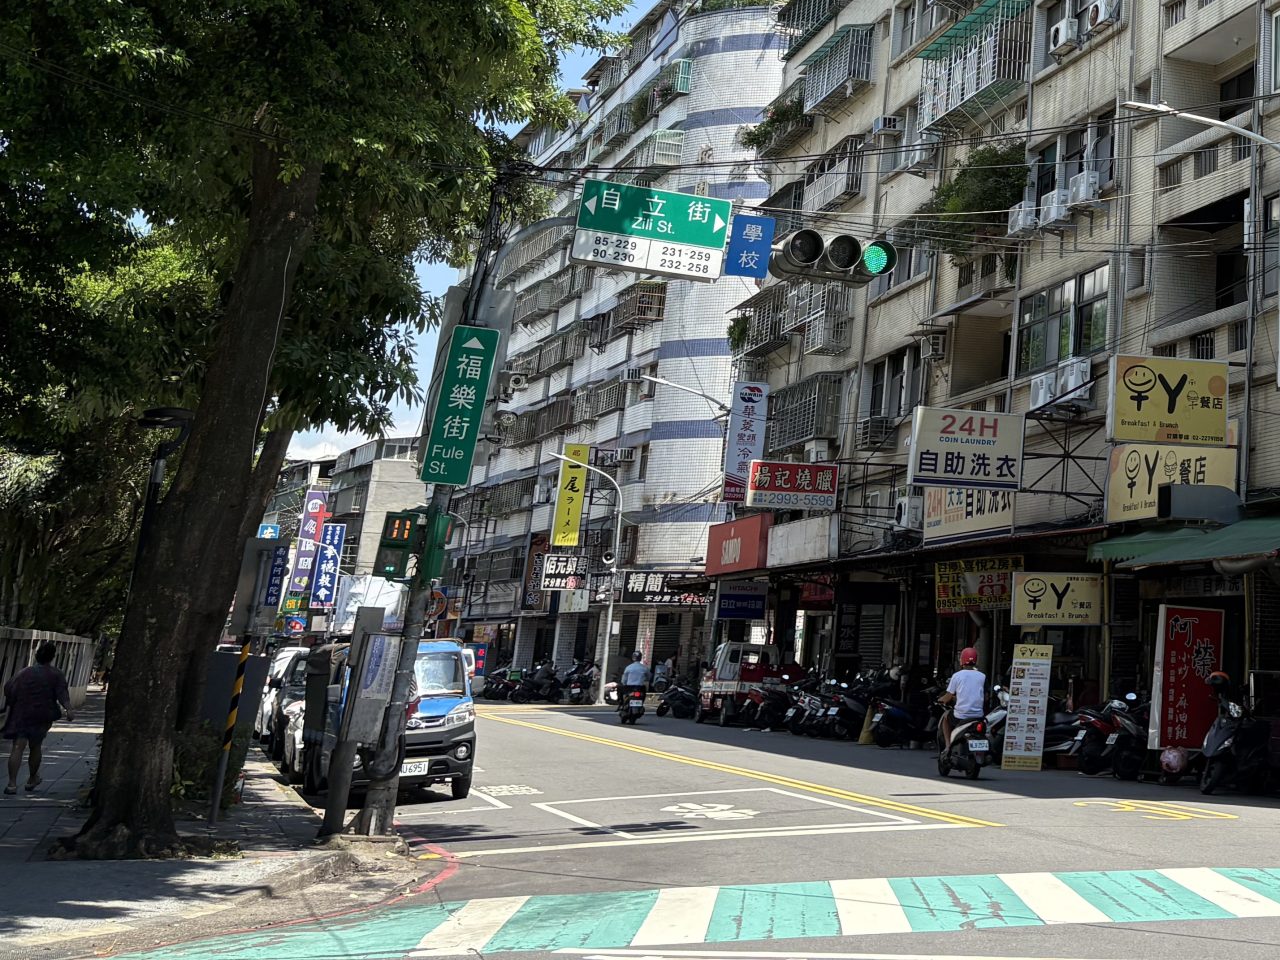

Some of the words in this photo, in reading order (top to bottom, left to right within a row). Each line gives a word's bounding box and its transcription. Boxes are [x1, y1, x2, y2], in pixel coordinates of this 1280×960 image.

[601, 188, 711, 224] 自立街
[631, 216, 653, 231] Zili
[656, 220, 675, 235] St.
[594, 235, 637, 251] 85-229
[738, 223, 763, 269] 學校
[592, 248, 635, 263] 90-230
[662, 246, 711, 262] 231-259
[659, 258, 709, 274] 232-258
[442, 353, 484, 441] 福樂街
[940, 414, 999, 438] 24H
[1121, 418, 1150, 428] Breakfast
[1159, 421, 1179, 429] Brunch
[939, 436, 959, 444] COIN
[960, 437, 997, 446] LAUNDRY
[431, 444, 464, 460] Fule
[429, 460, 448, 475] St.
[918, 449, 1017, 479] 自助洗衣
[752, 465, 833, 492] 楊記燒臘
[769, 493, 833, 507] 2993-5596
[926, 490, 943, 519] 24H
[392, 519, 411, 539] 11
[721, 537, 741, 566] SAMPO
[316, 545, 338, 600] 幸福教會
